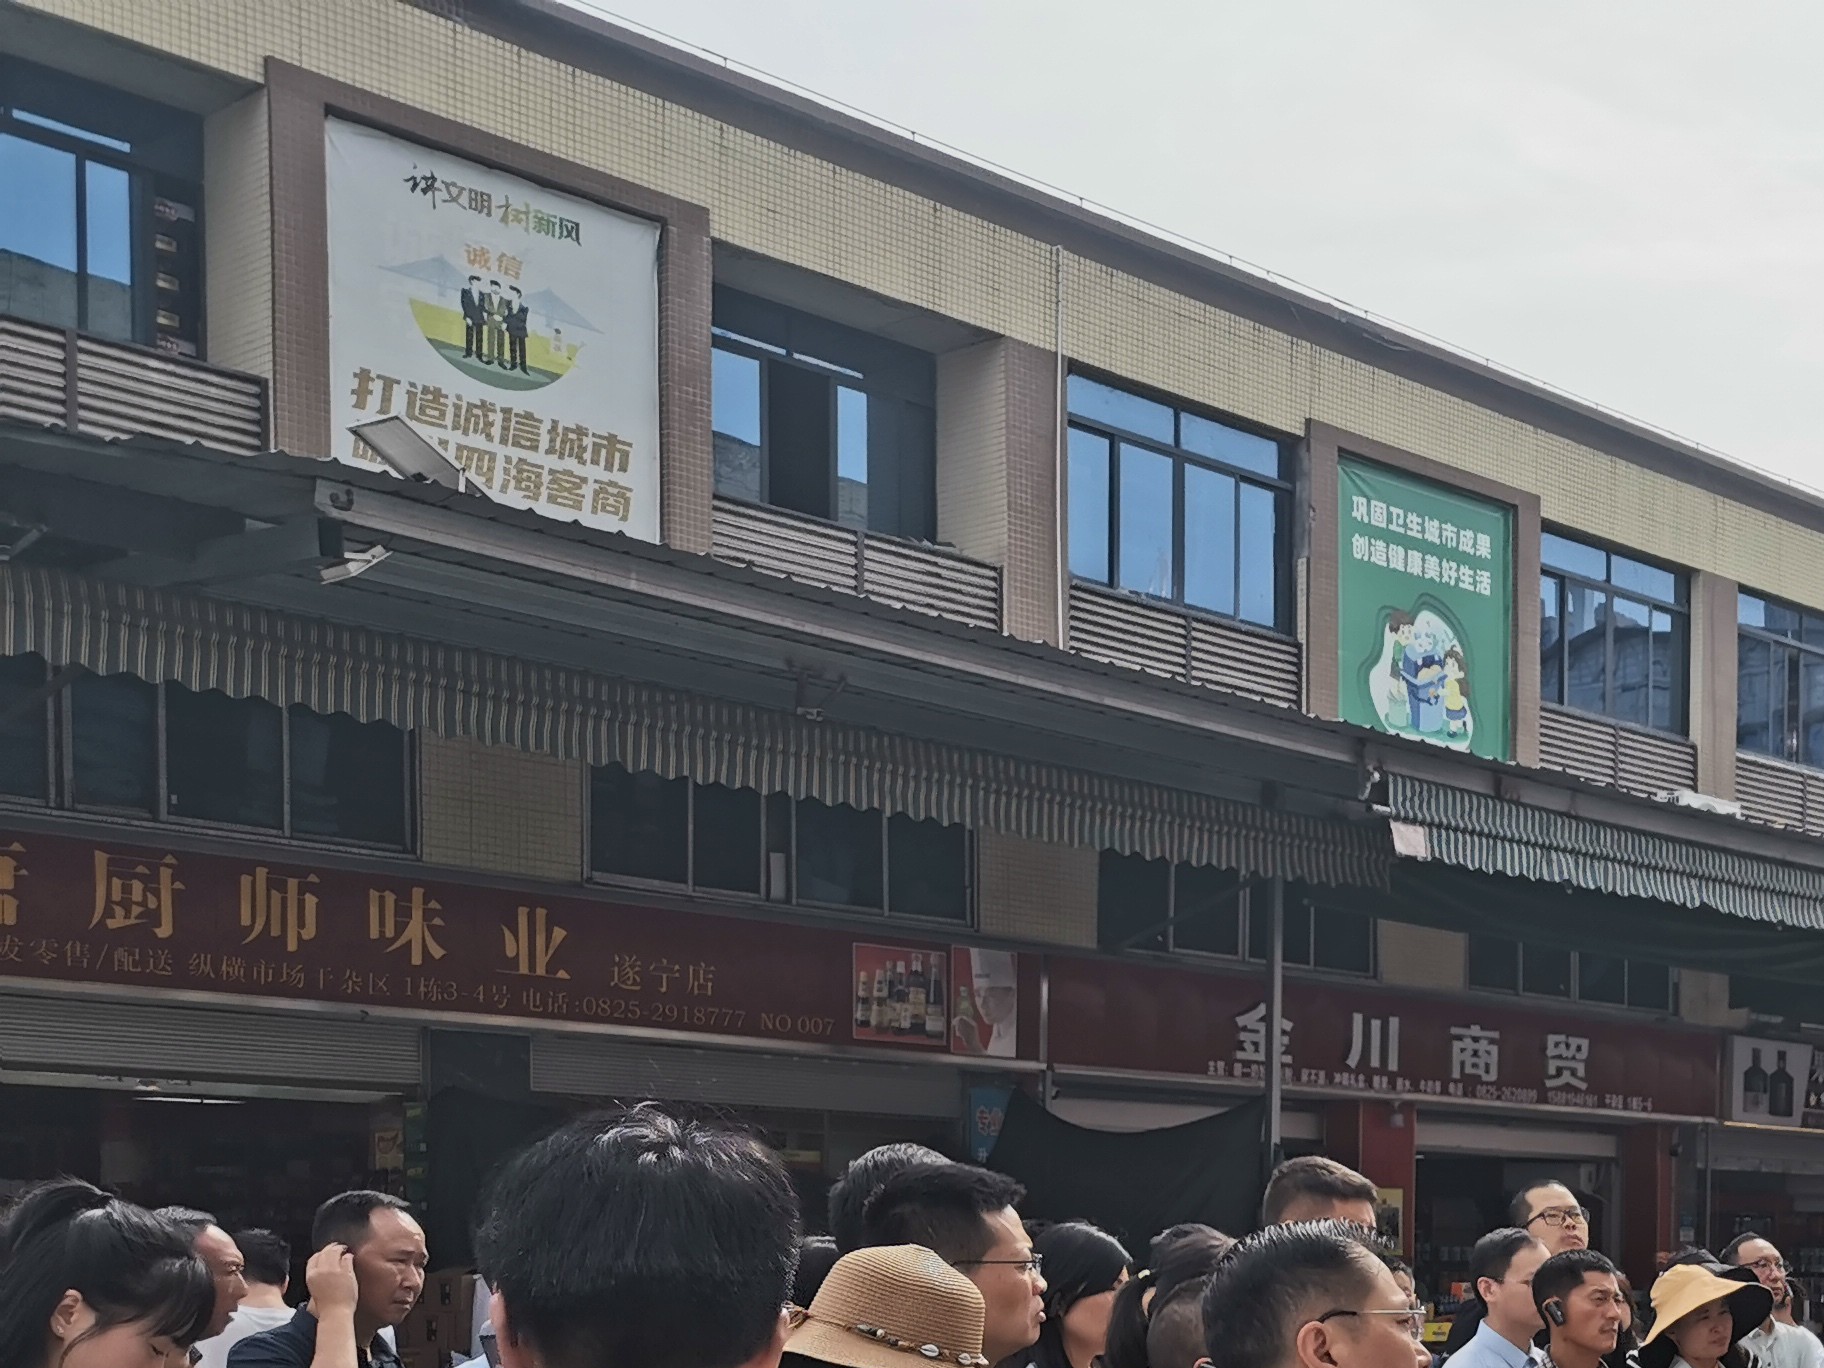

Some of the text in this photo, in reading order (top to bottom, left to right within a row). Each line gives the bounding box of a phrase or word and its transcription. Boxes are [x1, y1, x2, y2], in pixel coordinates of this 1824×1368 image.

[404, 163, 582, 247] 讲文明树新风
[464, 243, 524, 281] 诚信
[351, 366, 634, 474] 打造诚信城市
[352, 437, 634, 522] 四海客商
[1351, 494, 1492, 560] 巩固卫生城市成果
[1351, 533, 1492, 596] 创造健康美好生活
[609, 953, 717, 998] 遂宁店
[1234, 1002, 1590, 1090] 金川商贸
